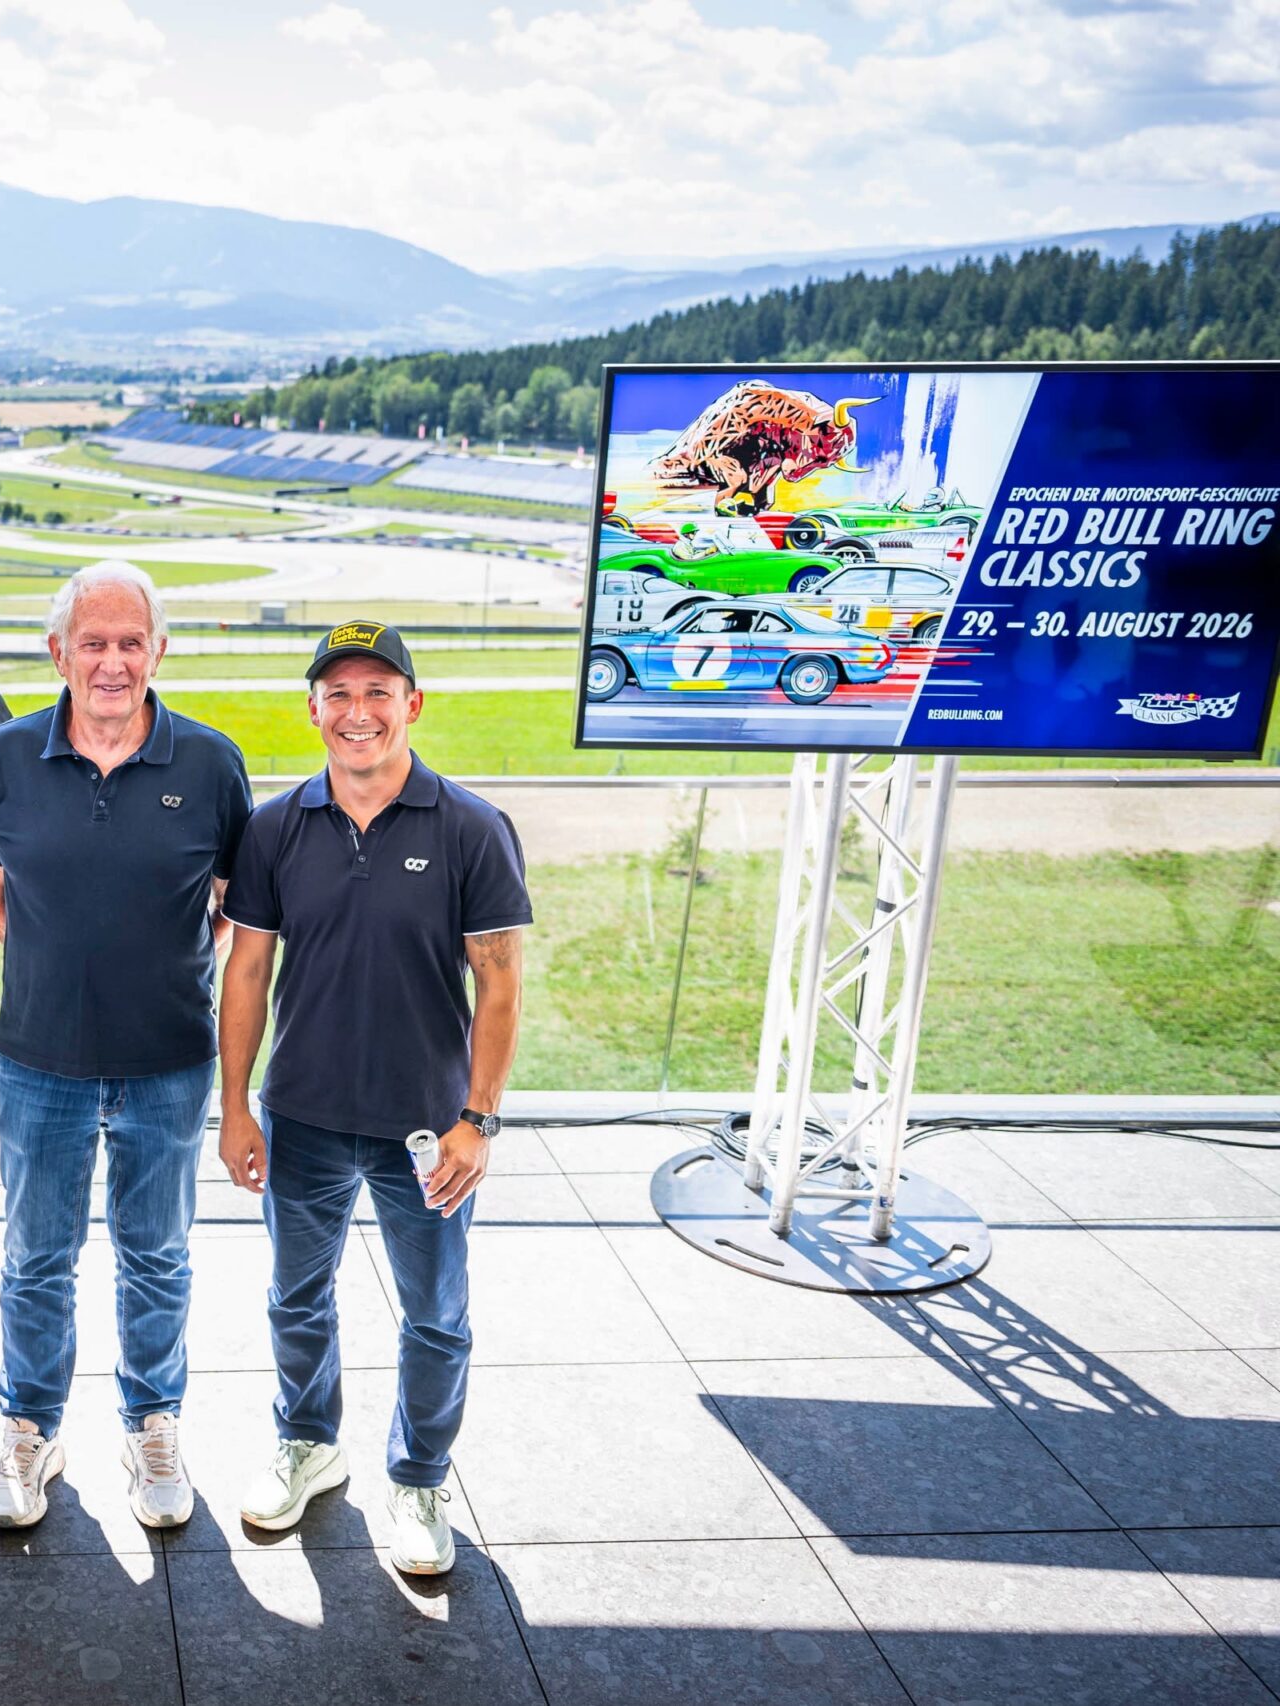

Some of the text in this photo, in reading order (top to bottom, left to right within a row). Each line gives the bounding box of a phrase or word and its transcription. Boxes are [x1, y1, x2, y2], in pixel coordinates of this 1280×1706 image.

[1008, 487, 1280, 502] EPOCHEN DER MOTORSPORT-GESCHICHTE
[992, 507, 1276, 546] RED BULL RING
[980, 550, 1148, 588] CLASSICS
[957, 610, 998, 637] 29.
[1030, 611, 1070, 637] 30.
[1076, 611, 1184, 638] AUGUST
[1185, 612, 1254, 639] 2026
[692, 645, 714, 678] 7
[928, 708, 1003, 721] REDBULLRING.COM
[1134, 707, 1189, 723] CLASSICS
